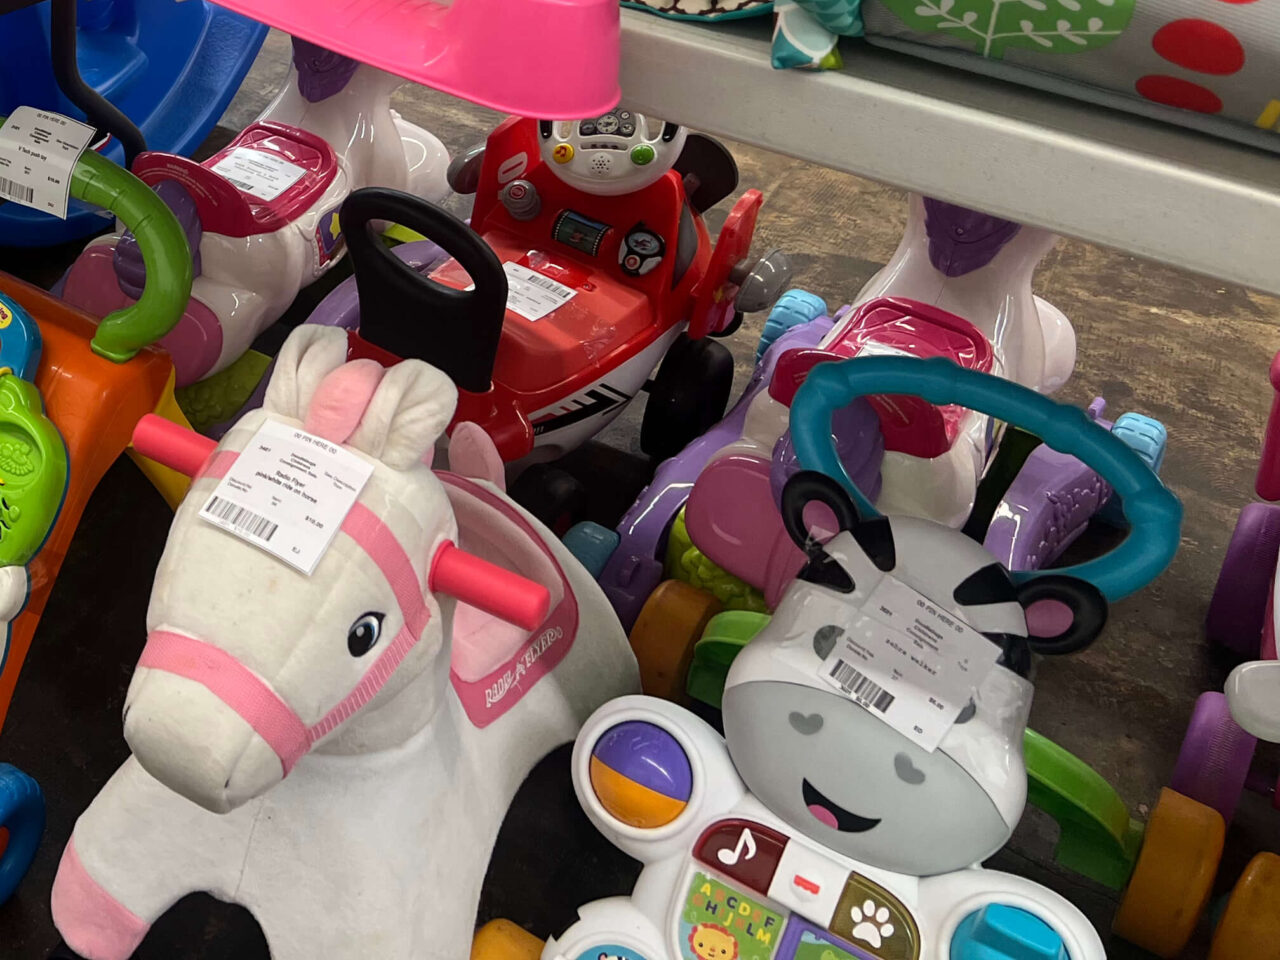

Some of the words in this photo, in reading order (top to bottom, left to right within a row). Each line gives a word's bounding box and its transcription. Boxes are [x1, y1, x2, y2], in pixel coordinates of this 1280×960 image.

[276, 470, 290, 481] Radio
[291, 477, 305, 488] Flyer
[282, 482, 293, 491] ride
[301, 491, 317, 504] horse
[911, 655, 936, 675] walker
